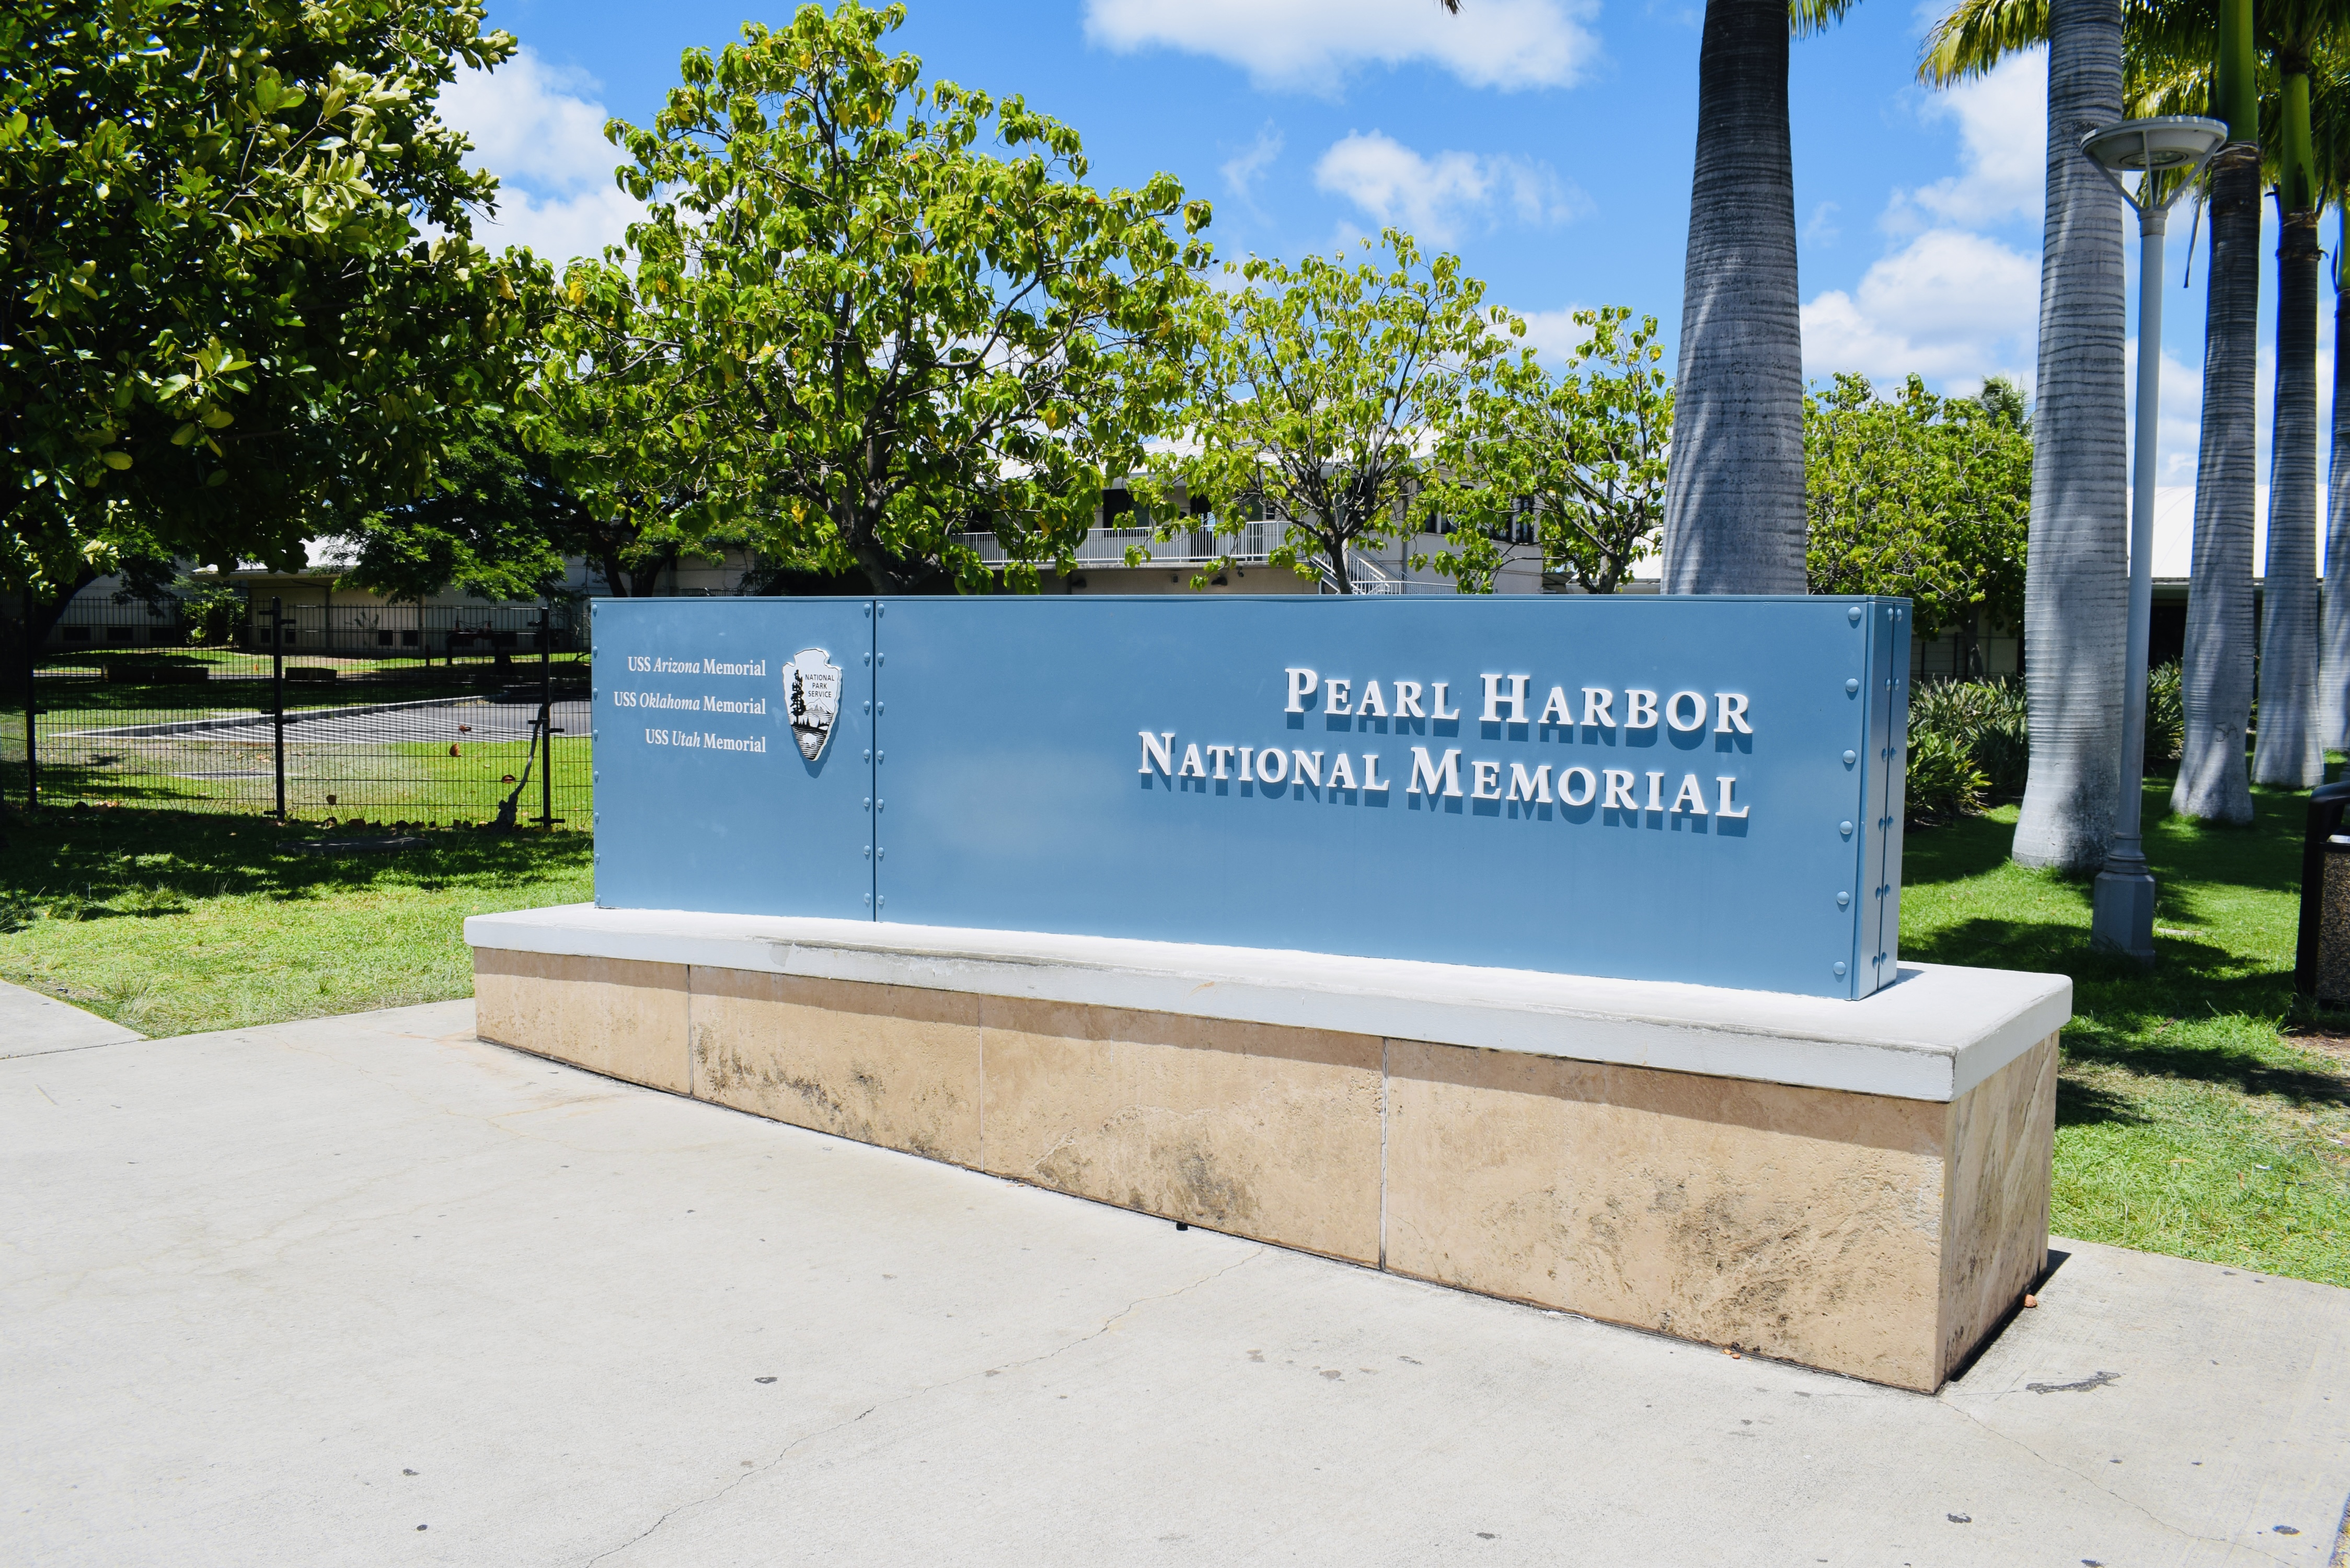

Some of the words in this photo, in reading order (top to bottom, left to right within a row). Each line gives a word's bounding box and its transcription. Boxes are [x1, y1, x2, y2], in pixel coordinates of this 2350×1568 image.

[628, 656, 651, 672] USS
[653, 657, 700, 674] Arizona
[702, 658, 766, 676] Memorial
[614, 691, 637, 707] USS
[639, 692, 700, 711] Oklahoma
[702, 696, 766, 714] Memorial
[1284, 667, 1460, 720] PEARL
[1478, 673, 1754, 734] HARBOR
[645, 728, 669, 745] USS
[672, 730, 700, 747] Utah
[703, 733, 766, 753] Memorial
[1137, 731, 1390, 791] NATIONAL
[1405, 746, 1750, 818] MEMORIAL
